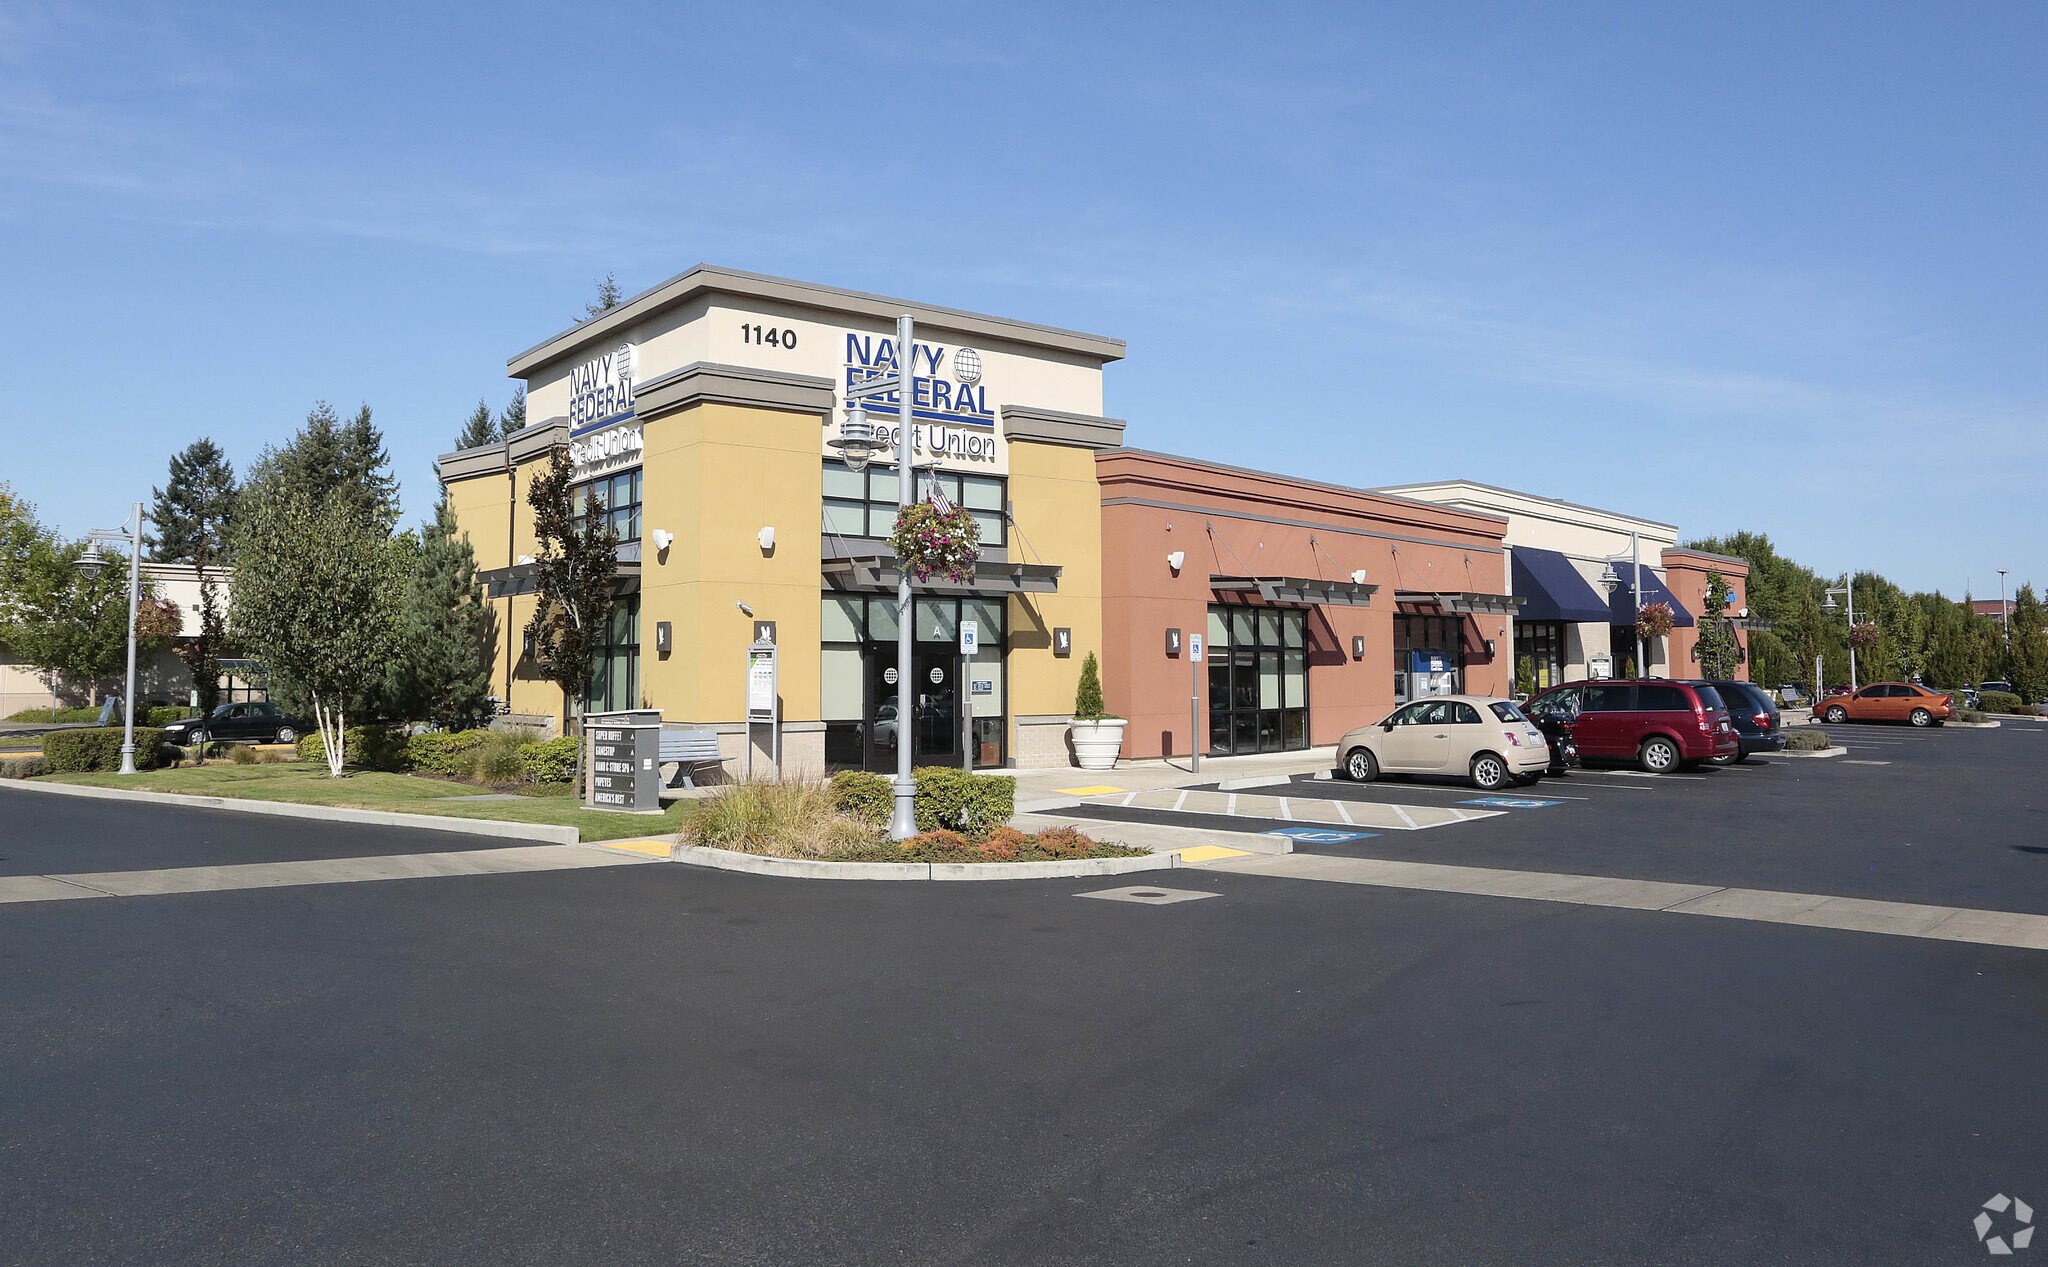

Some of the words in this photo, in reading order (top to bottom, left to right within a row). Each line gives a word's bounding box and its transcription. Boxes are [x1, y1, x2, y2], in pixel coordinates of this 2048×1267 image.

[741, 323, 797, 350] 1140
[569, 353, 613, 398] NAVY
[569, 377, 635, 428] FEDERAL
[603, 427, 637, 457] Union
[929, 424, 995, 456] Union
[596, 731, 608, 740] SUPER
